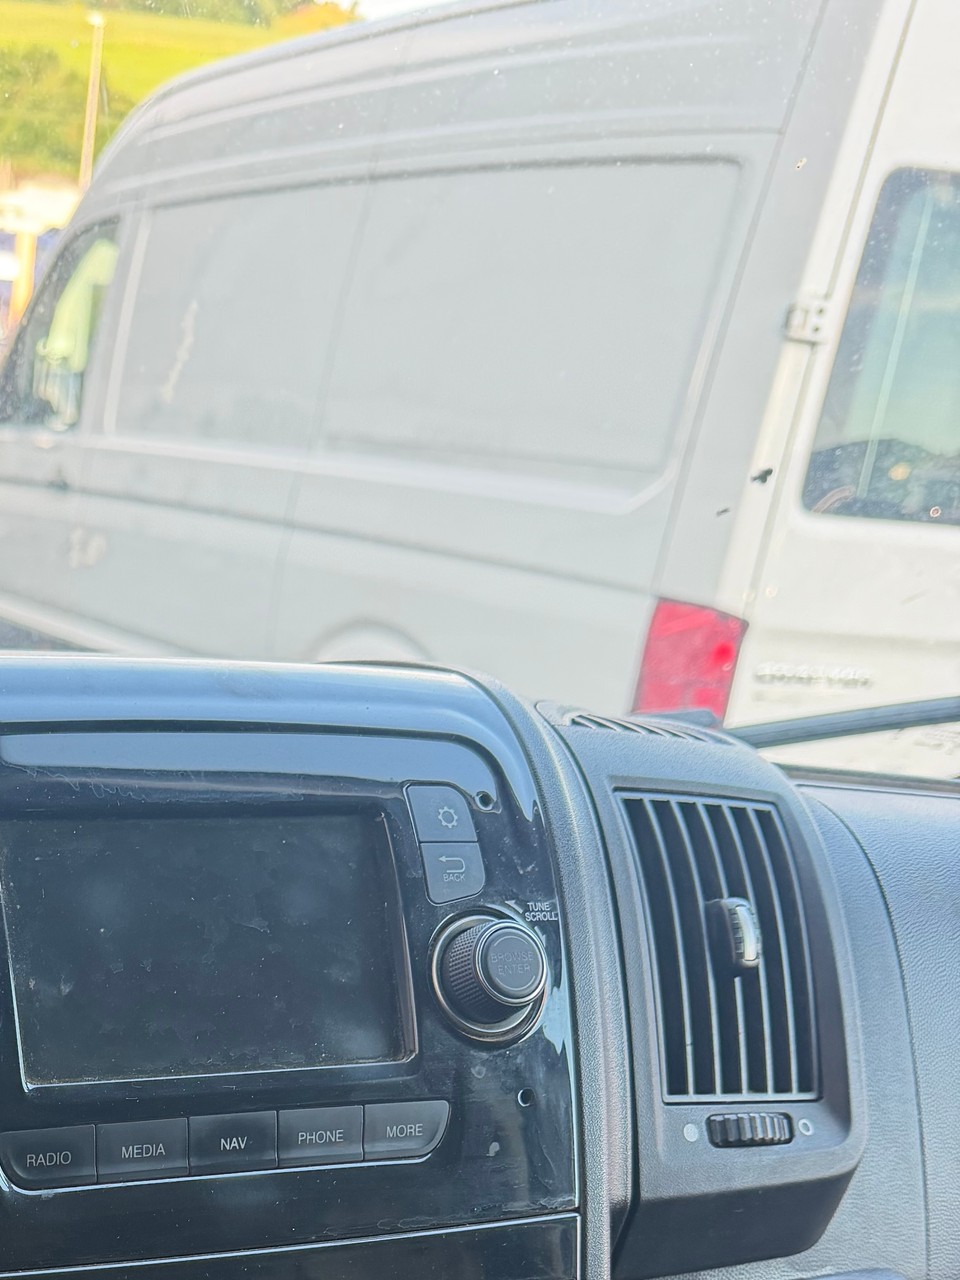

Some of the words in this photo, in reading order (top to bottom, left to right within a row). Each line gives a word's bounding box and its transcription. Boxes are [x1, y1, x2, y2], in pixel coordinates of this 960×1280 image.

[443, 873, 465, 882] BACK
[527, 902, 550, 911] TUNE
[525, 912, 558, 921] SCROLL
[491, 951, 534, 963] BROWSE
[498, 963, 531, 975] ENTER
[298, 1129, 344, 1144] PHONE
[386, 1123, 423, 1138] MORE
[220, 1136, 248, 1151] NAV
[121, 1143, 166, 1159] MEDIA
[26, 1151, 72, 1167] RADIO
